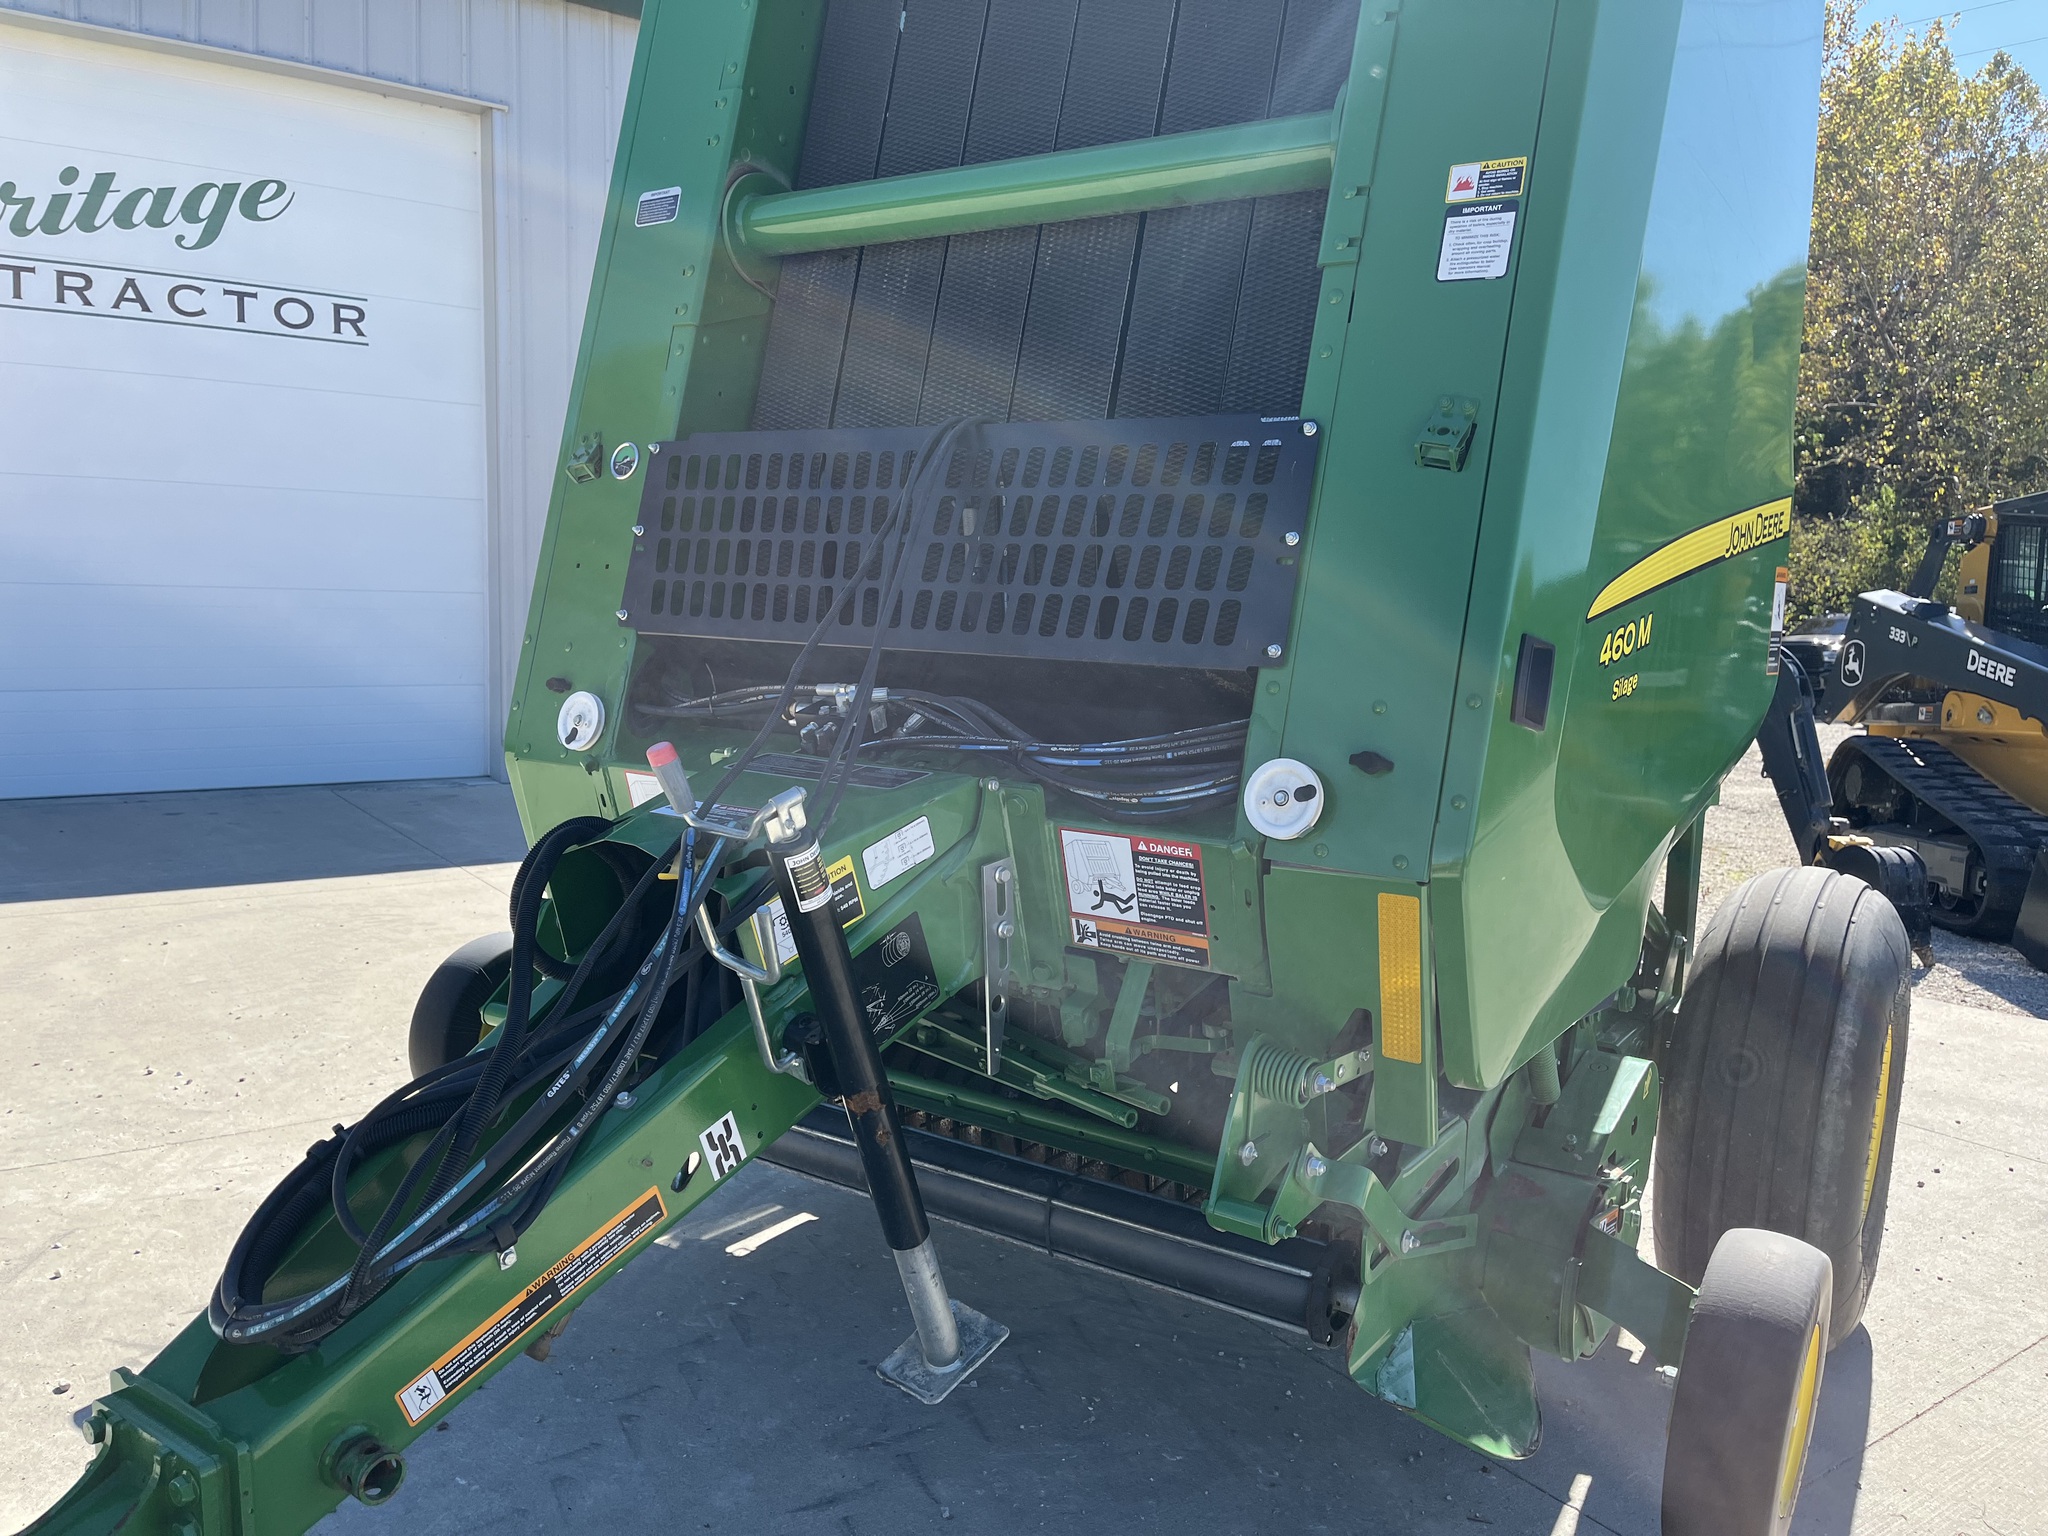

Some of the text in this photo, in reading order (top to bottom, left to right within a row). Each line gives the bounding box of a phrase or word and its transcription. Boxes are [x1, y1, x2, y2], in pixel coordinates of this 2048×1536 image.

[1491, 159, 1524, 169] CAUTION
[1462, 204, 1502, 214] IMPORTANT
[0, 264, 367, 337] TRACTOR
[1727, 511, 1785, 551] JOHN DEERE
[1599, 613, 1653, 667] 460 M
[1889, 626, 1906, 644] 333
[1966, 649, 2017, 687] DEERE
[1612, 673, 1639, 701] Silage
[1149, 844, 1193, 857] DANGER
[792, 856, 809, 867] JOHN
[1141, 912, 1164, 920] Disengage
[1133, 929, 1176, 943] WARNING
[624, 1048, 634, 1060] SAE
[547, 1071, 570, 1098] GATES
[603, 1083, 612, 1094] ISO
[581, 1110, 593, 1122] Type
[556, 1135, 571, 1152] Flame
[534, 1151, 558, 1173] Resistant
[521, 1172, 536, 1186] MSHA
[414, 1211, 431, 1228] MSHA
[531, 1252, 576, 1290] WARNING
